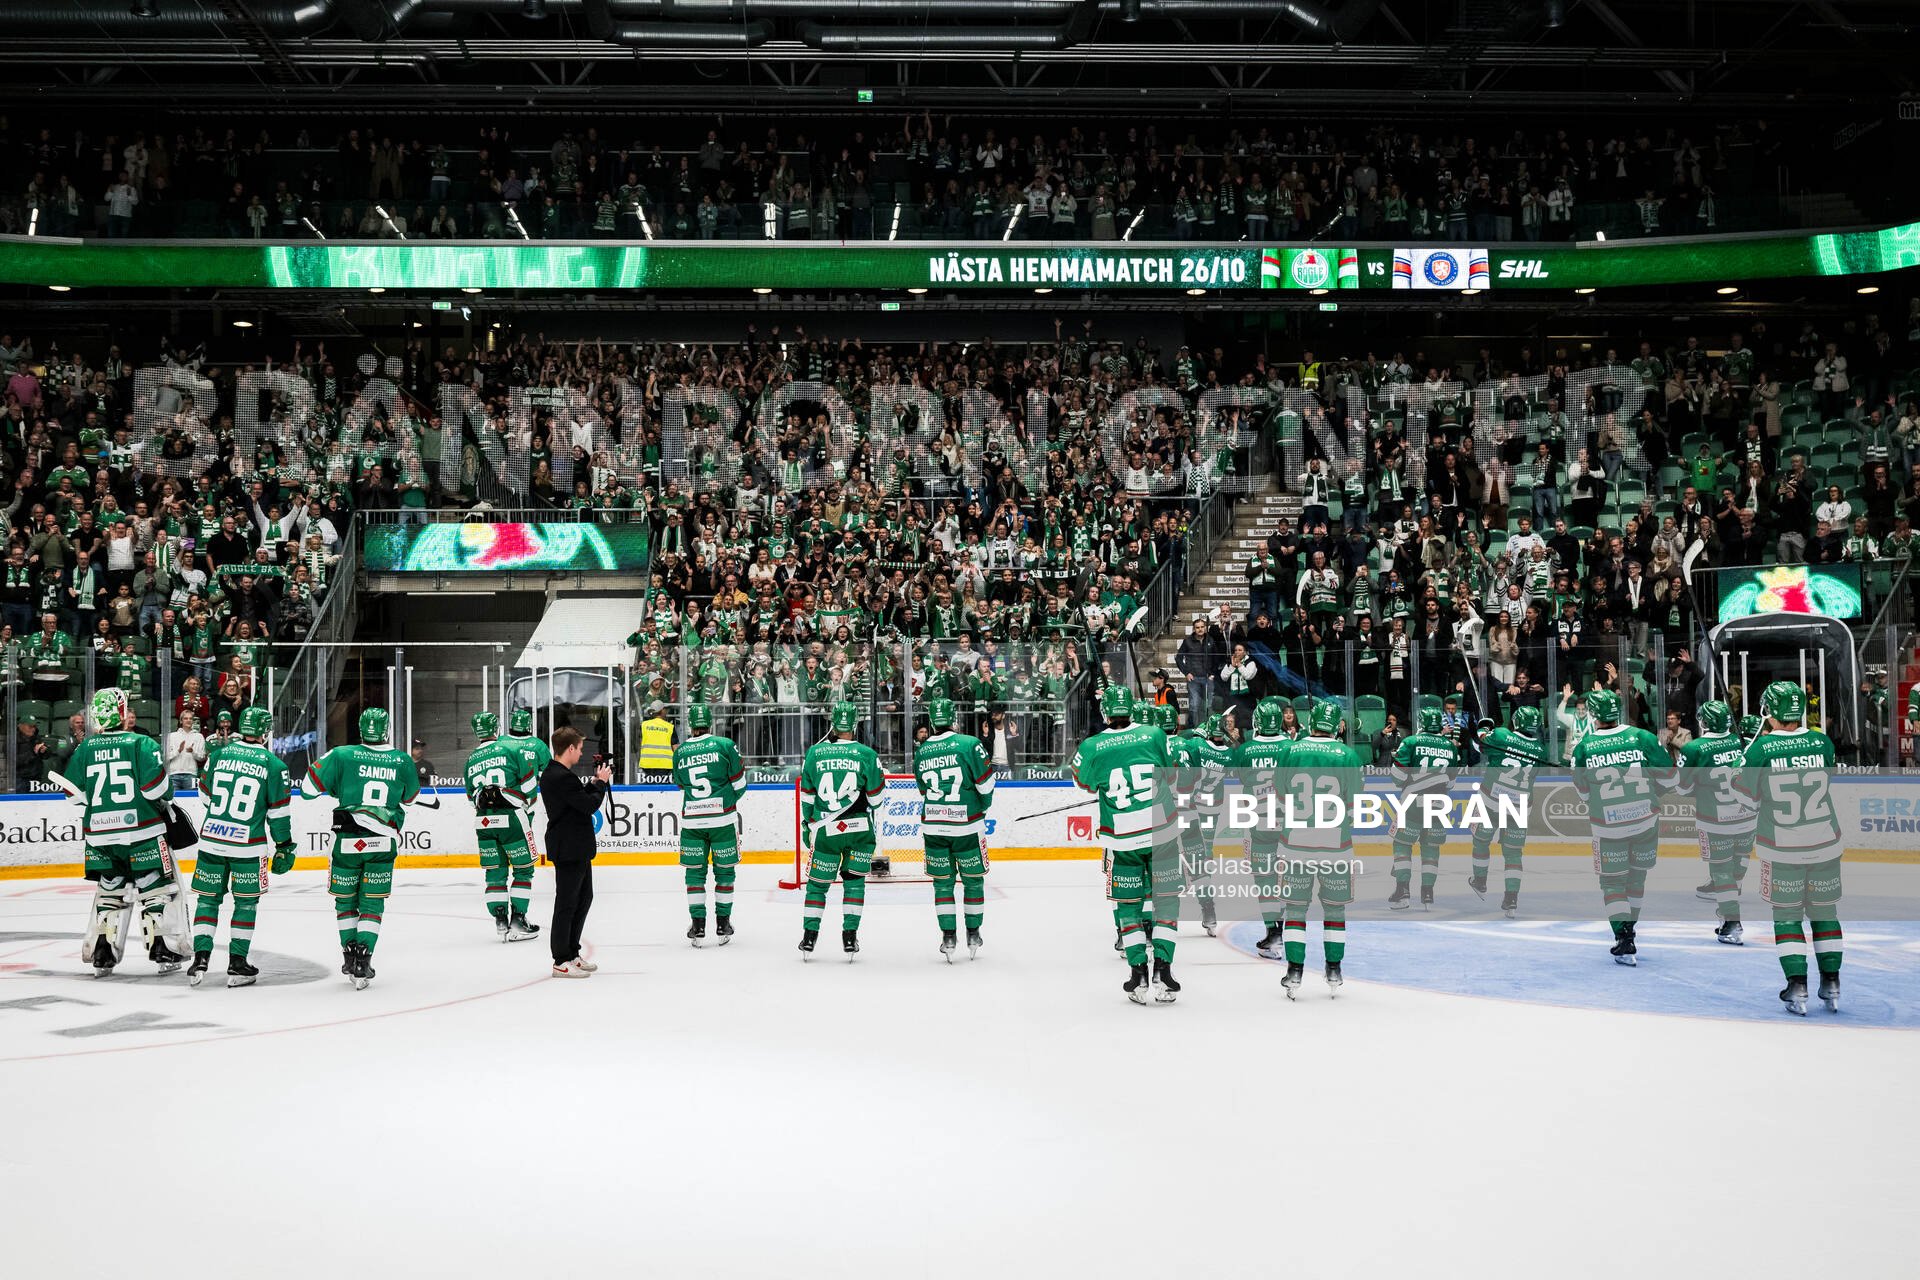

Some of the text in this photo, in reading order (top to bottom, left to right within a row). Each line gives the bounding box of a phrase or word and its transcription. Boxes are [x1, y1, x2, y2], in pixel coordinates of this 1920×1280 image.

[930, 252, 1246, 283] NÄSTA HEMMAMATCH 26/10
[1367, 261, 1385, 275] VS
[1498, 259, 1550, 279] SHL
[1098, 364, 1656, 495] CENTER
[94, 748, 121, 762] HOLM
[677, 751, 720, 770] CLAESSON
[1415, 745, 1454, 760] FERGUSON
[213, 759, 269, 780] JOHANSSON
[358, 764, 397, 781] SANDIN
[816, 759, 860, 772] PETERSON
[919, 754, 959, 772] SUNDSVIK
[1770, 753, 1825, 773] NILSSON
[86, 760, 135, 807] 75
[688, 765, 712, 799] 5
[753, 771, 791, 784] Boozt
[921, 766, 964, 802] 37
[1026, 768, 1063, 780] Boozt
[1594, 761, 1650, 800] 24
[209, 771, 261, 822] 58
[817, 771, 860, 812] 44
[1105, 763, 1158, 810] 45
[1768, 770, 1831, 825] 52
[947, 807, 967, 818] Design
